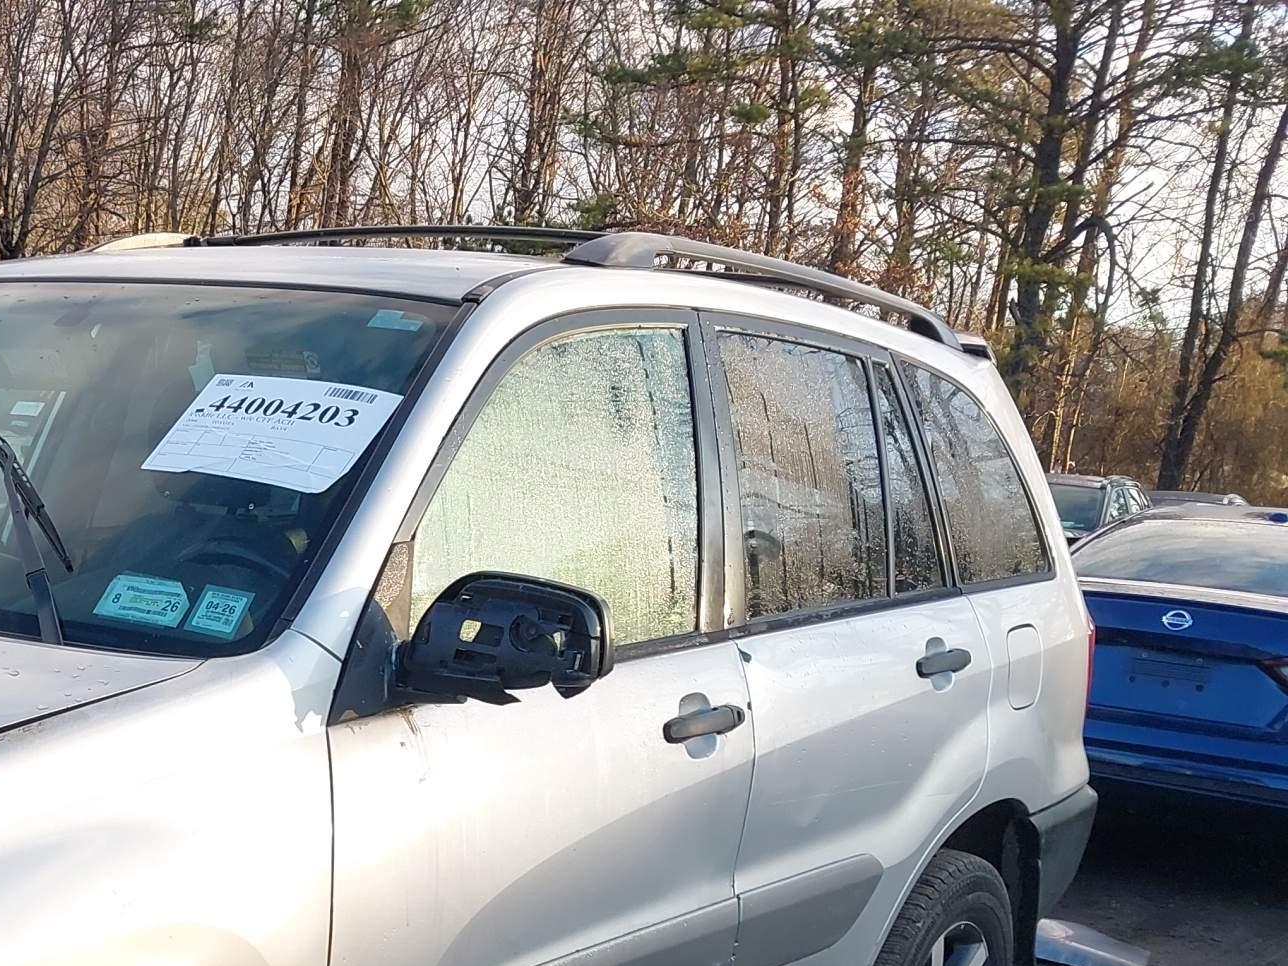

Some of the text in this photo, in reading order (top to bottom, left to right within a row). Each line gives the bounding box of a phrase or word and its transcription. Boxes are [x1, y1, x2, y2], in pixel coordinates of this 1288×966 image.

[208, 394, 360, 428] 44004203
[112, 593, 122, 604] 8
[161, 600, 180, 614] 26
[205, 600, 238, 615] 04-26
